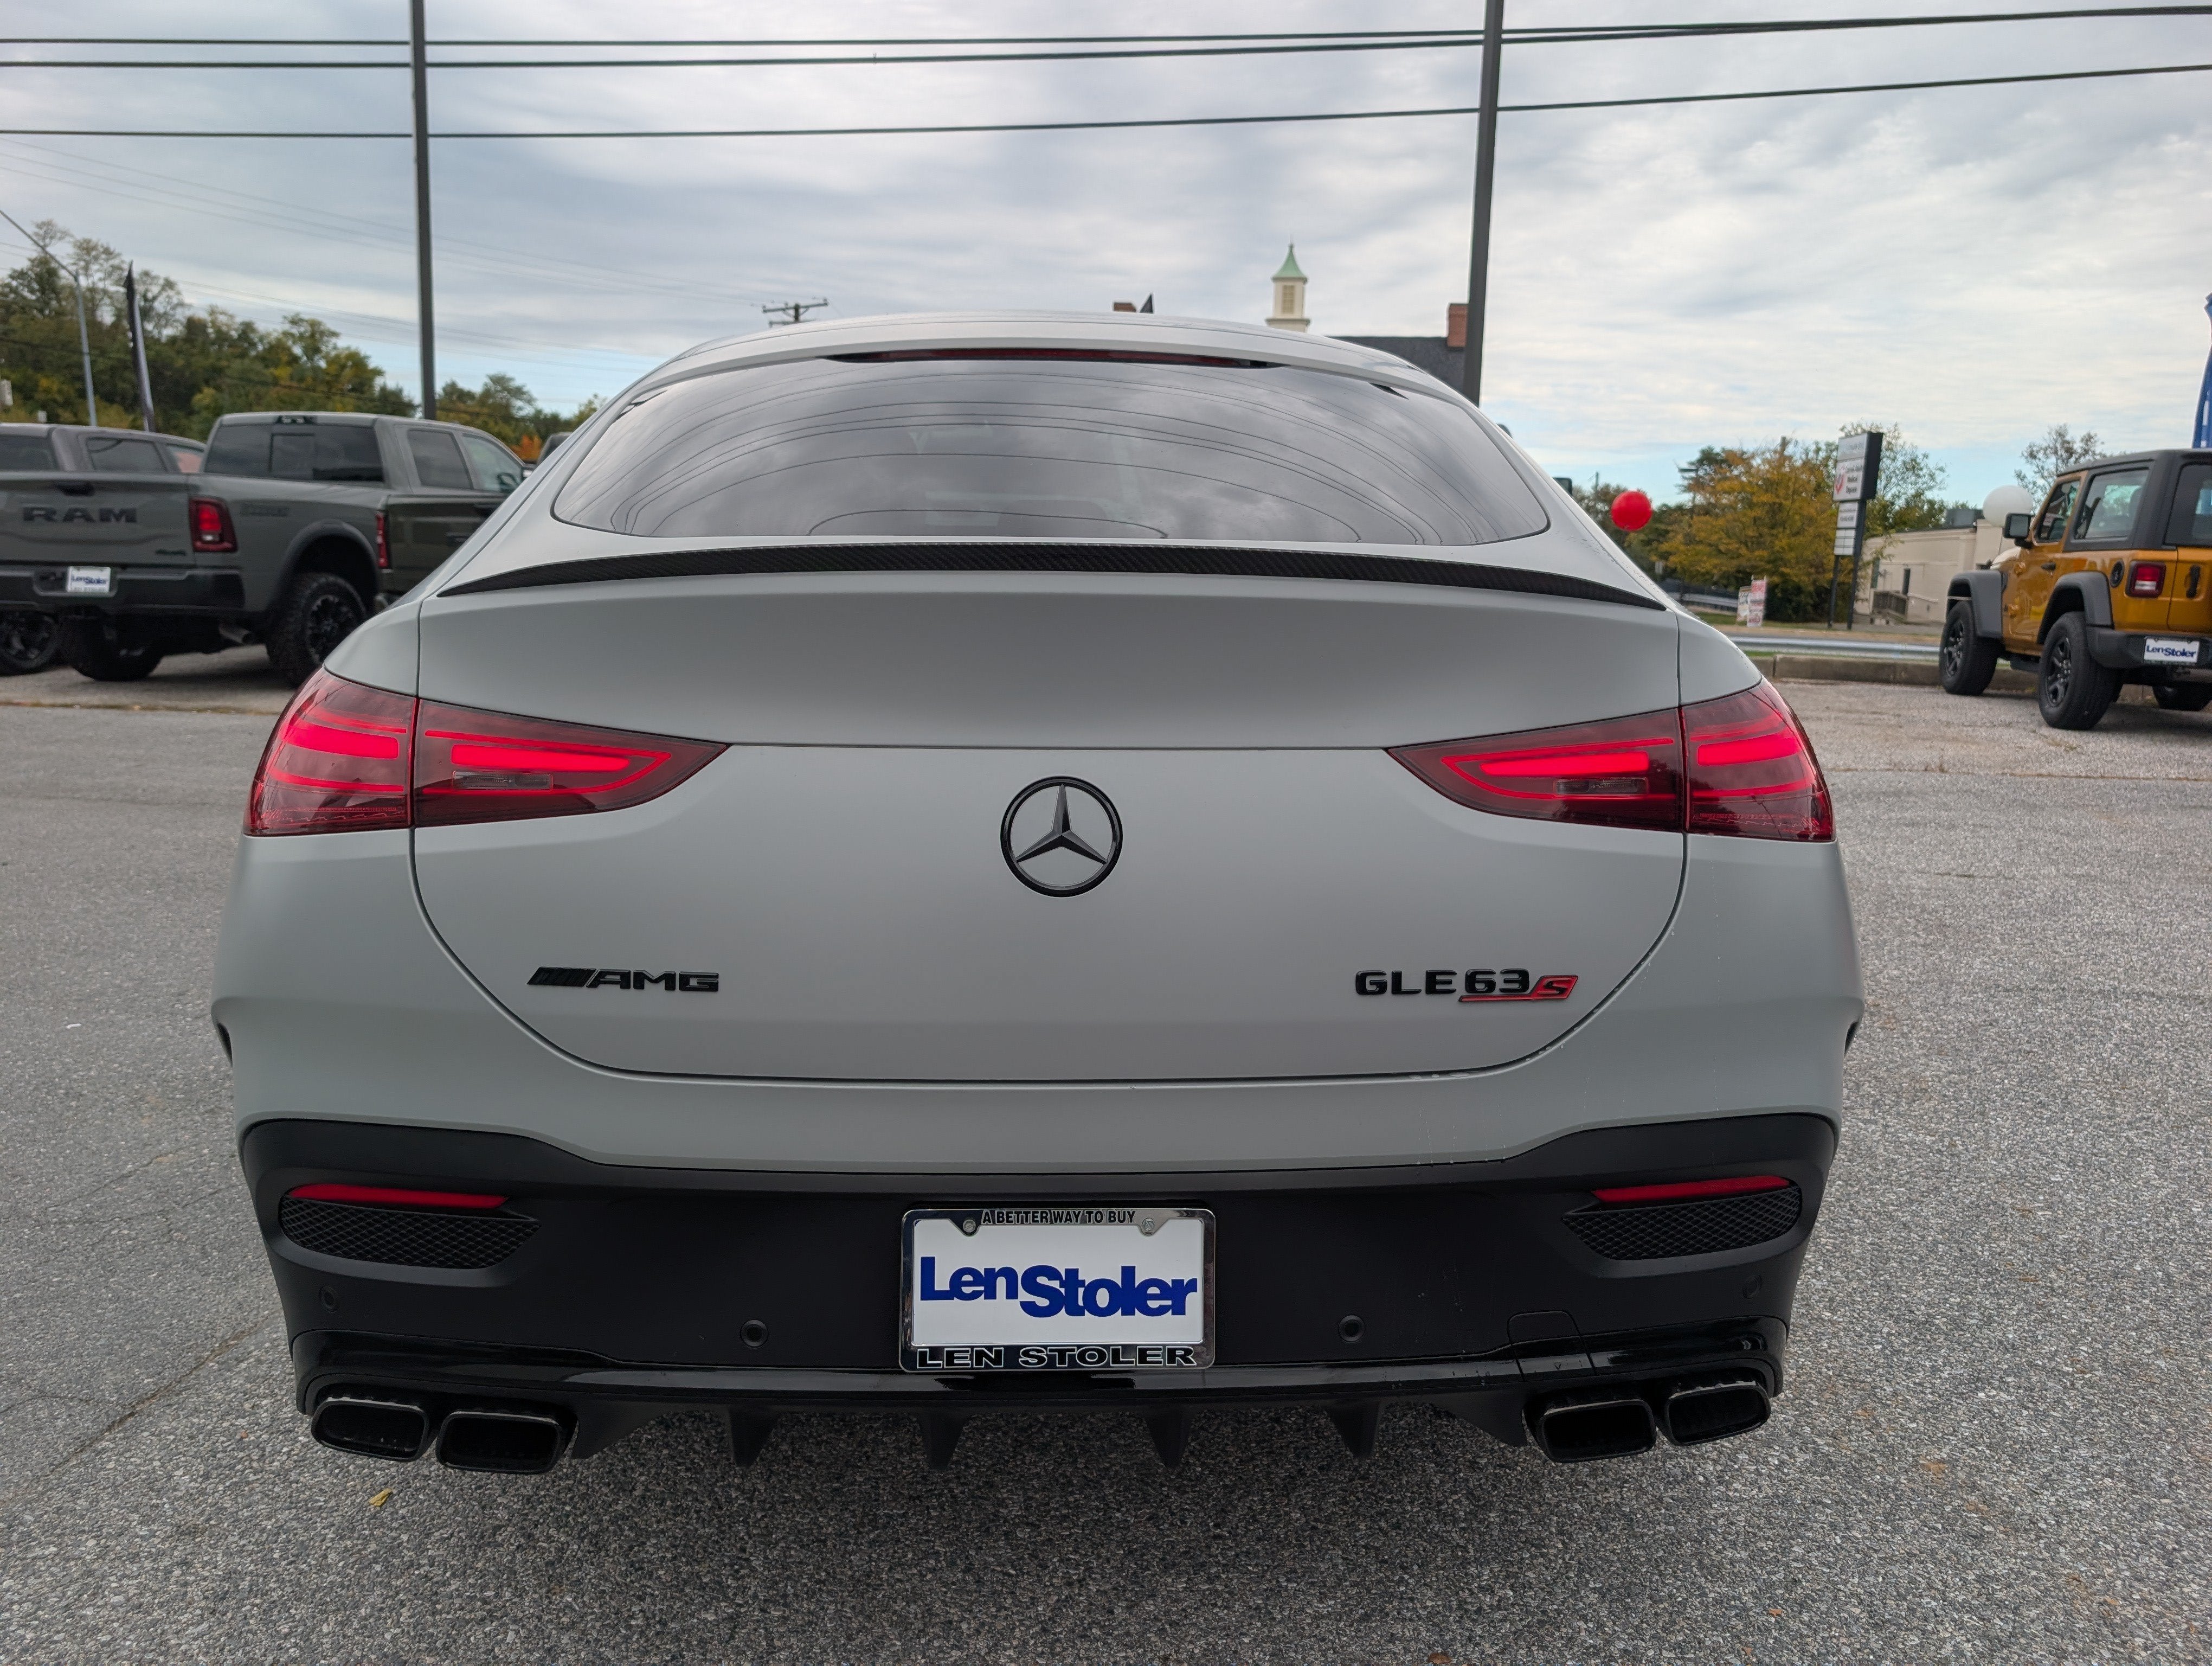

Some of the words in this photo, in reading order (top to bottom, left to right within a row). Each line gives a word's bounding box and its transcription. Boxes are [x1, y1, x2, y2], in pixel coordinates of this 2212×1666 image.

[24, 507, 137, 522] RAM
[586, 969, 719, 991] AMG
[981, 1209, 993, 1224] A
[996, 1209, 1050, 1224] BETTER
[1051, 1210, 1083, 1223] WAY
[1085, 1210, 1105, 1223] TO
[1107, 1210, 1136, 1224] BUY
[917, 1347, 1005, 1369] LEN
[1018, 1345, 1197, 1367] STOLER
